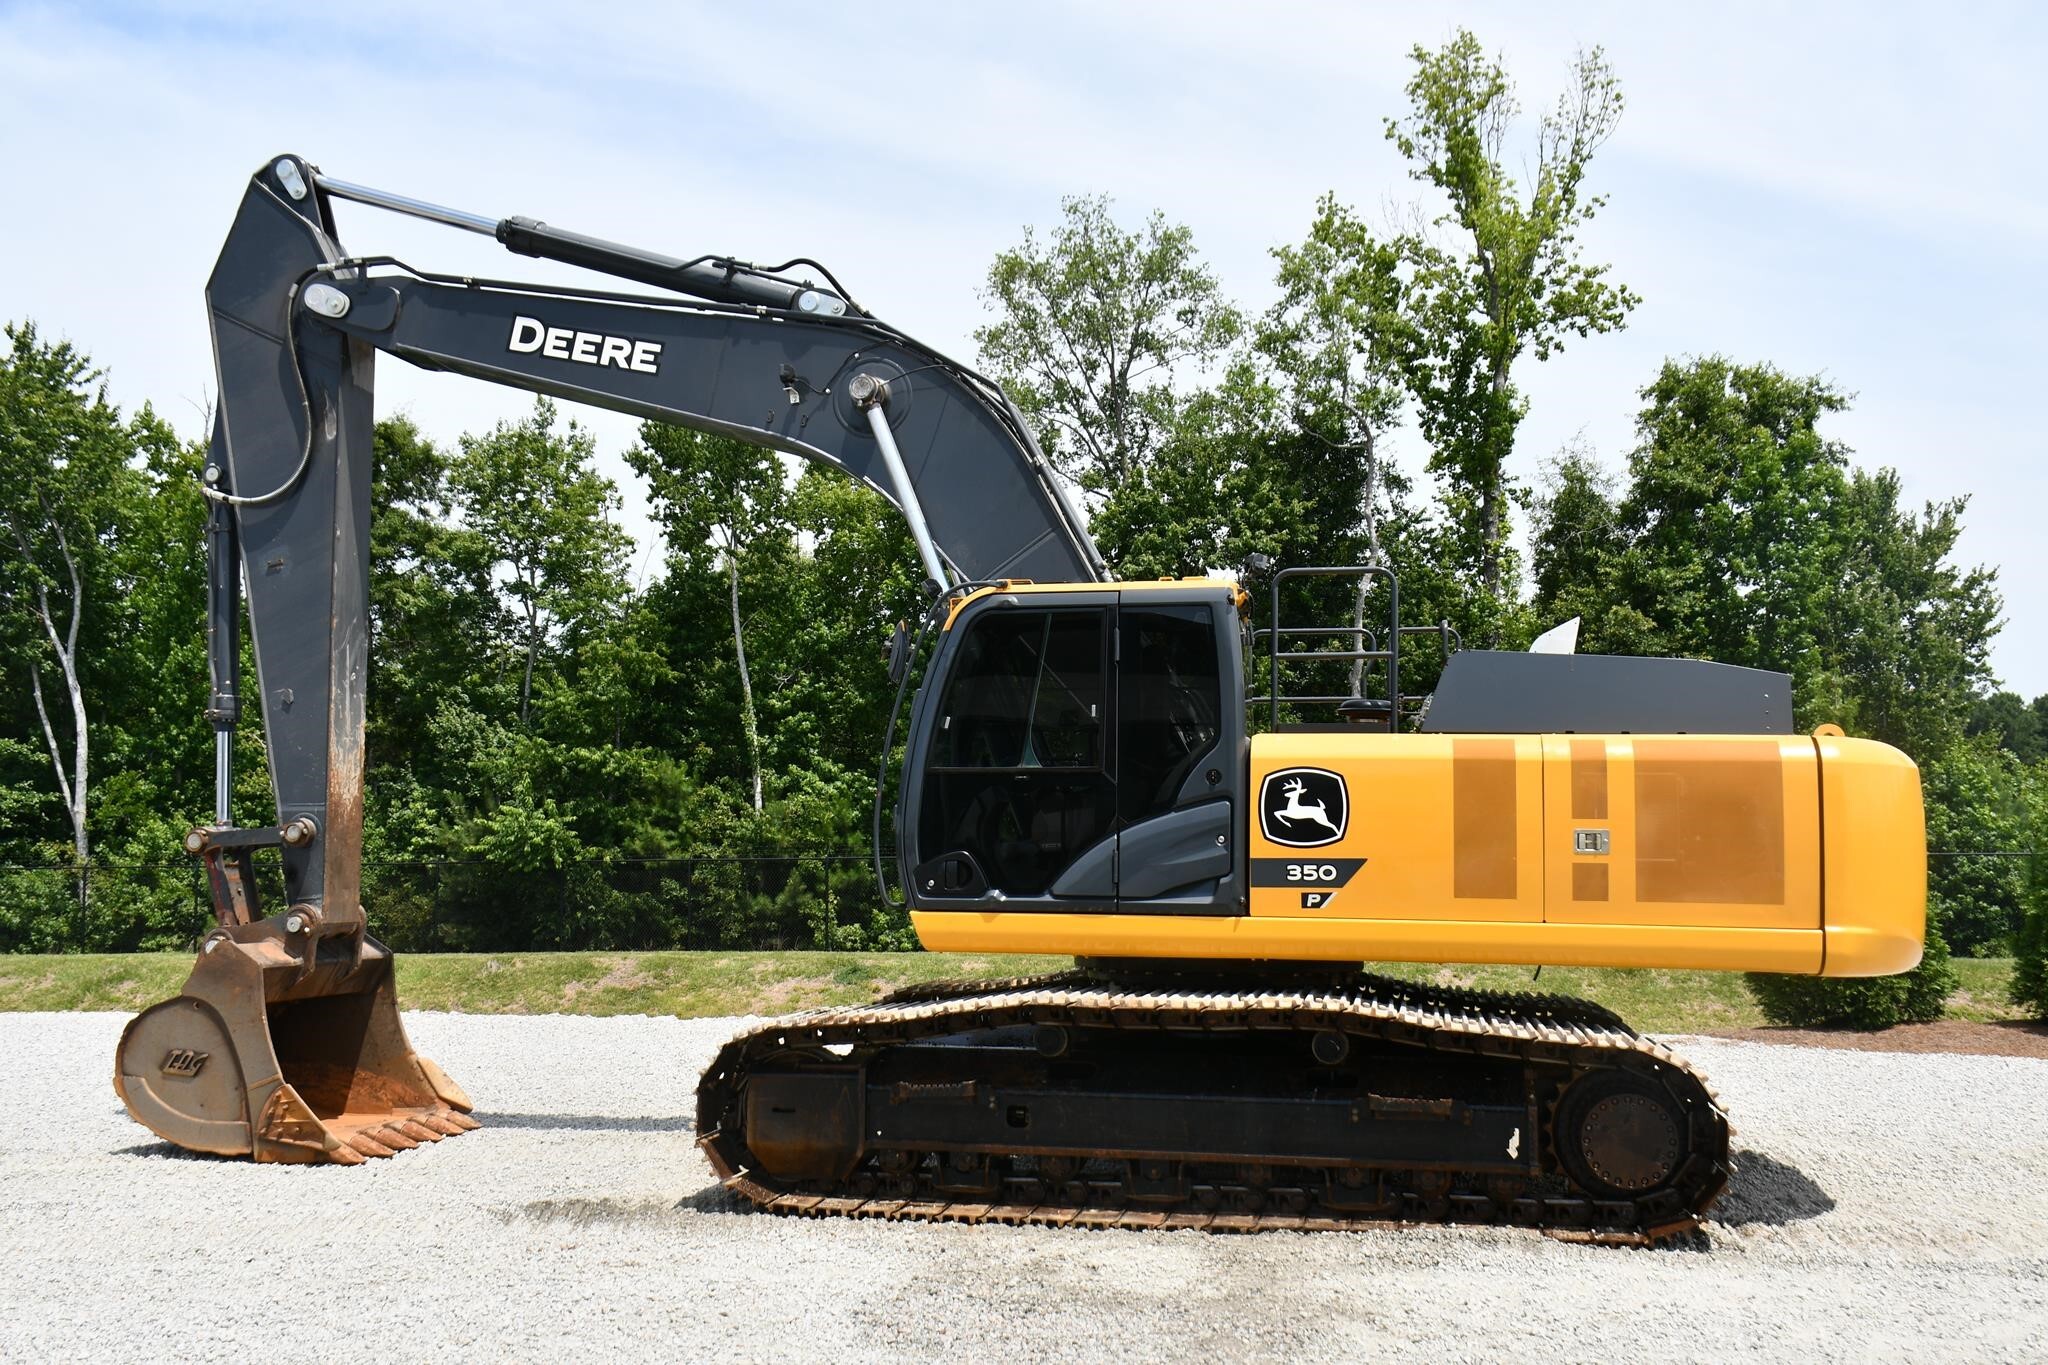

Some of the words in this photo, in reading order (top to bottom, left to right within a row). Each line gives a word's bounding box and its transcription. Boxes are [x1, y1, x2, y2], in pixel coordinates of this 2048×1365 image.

[509, 315, 662, 374] DEERE
[1286, 864, 1337, 881] 350
[1306, 894, 1321, 907] P
